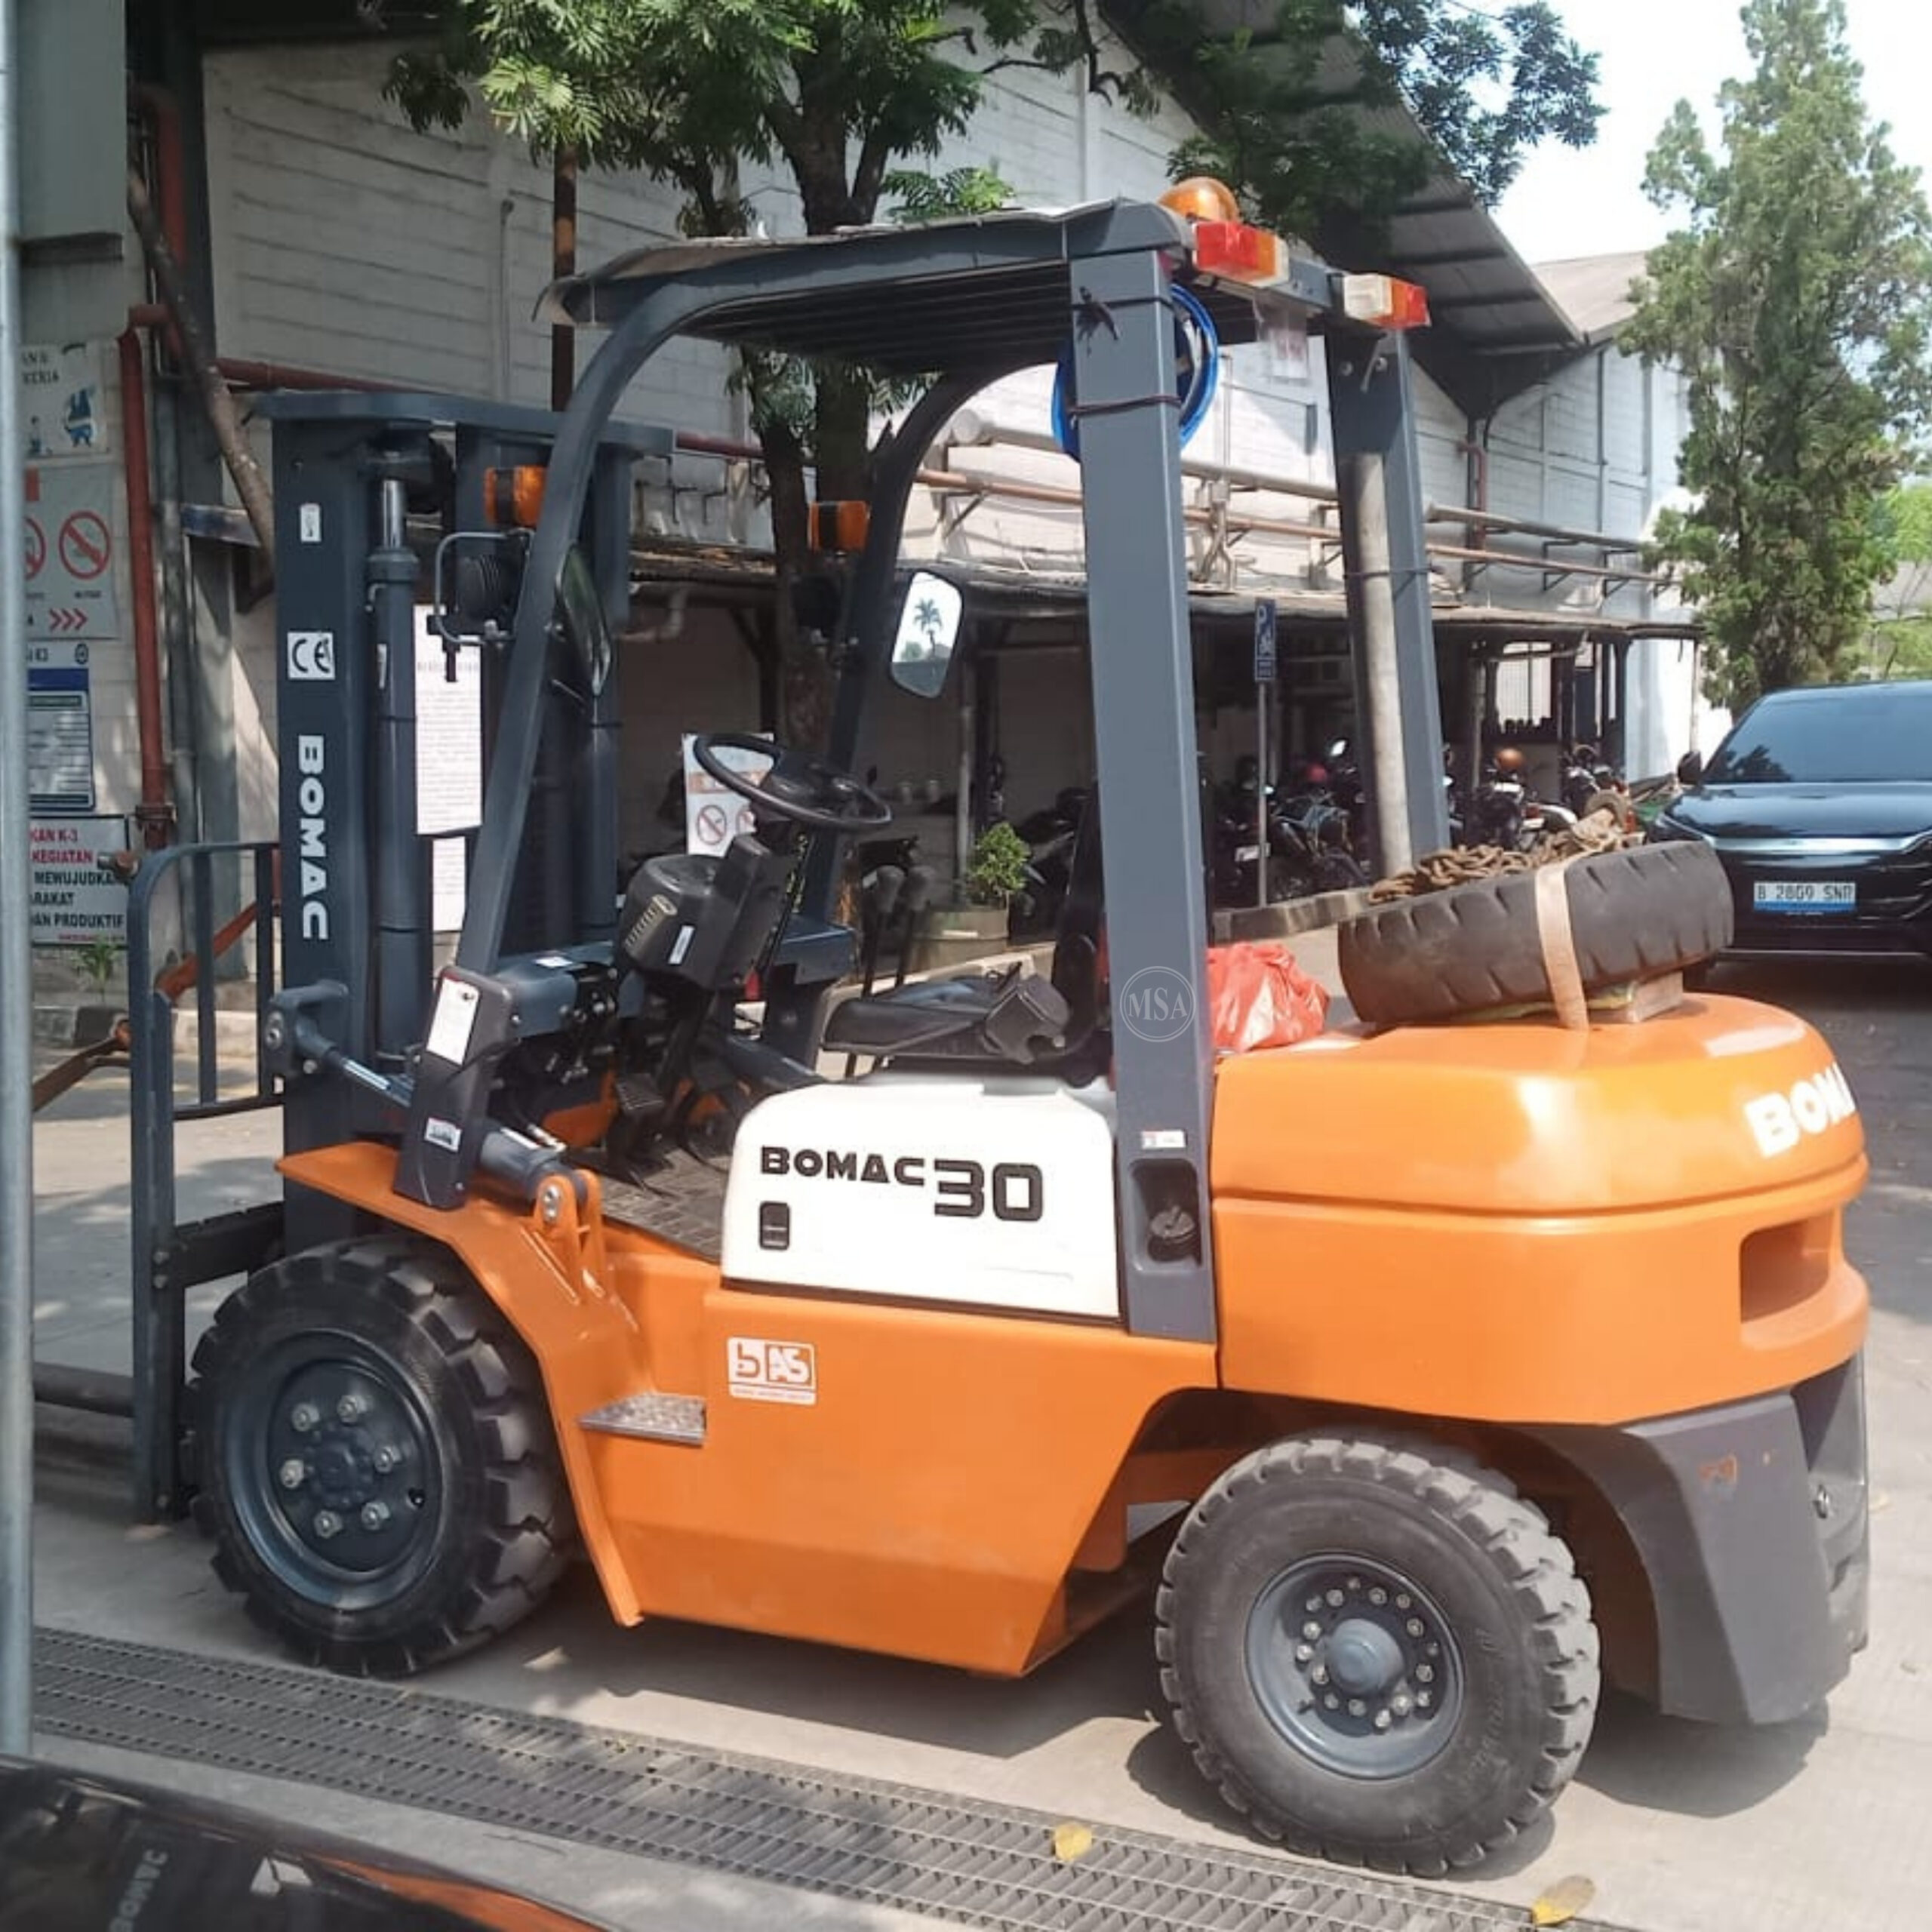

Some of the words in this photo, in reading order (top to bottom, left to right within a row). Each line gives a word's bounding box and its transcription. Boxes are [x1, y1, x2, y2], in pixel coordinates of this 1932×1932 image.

[291, 638, 331, 674] CE
[298, 734, 329, 940] BOMAC
[32, 848, 93, 863] KEGIATAN
[34, 871, 115, 886] MEWUJUDKA
[1758, 884, 1766, 900] B
[54, 912, 125, 928] PRODUKTIF
[761, 1146, 926, 1186] BOMAC
[934, 1158, 1044, 1222] 30
